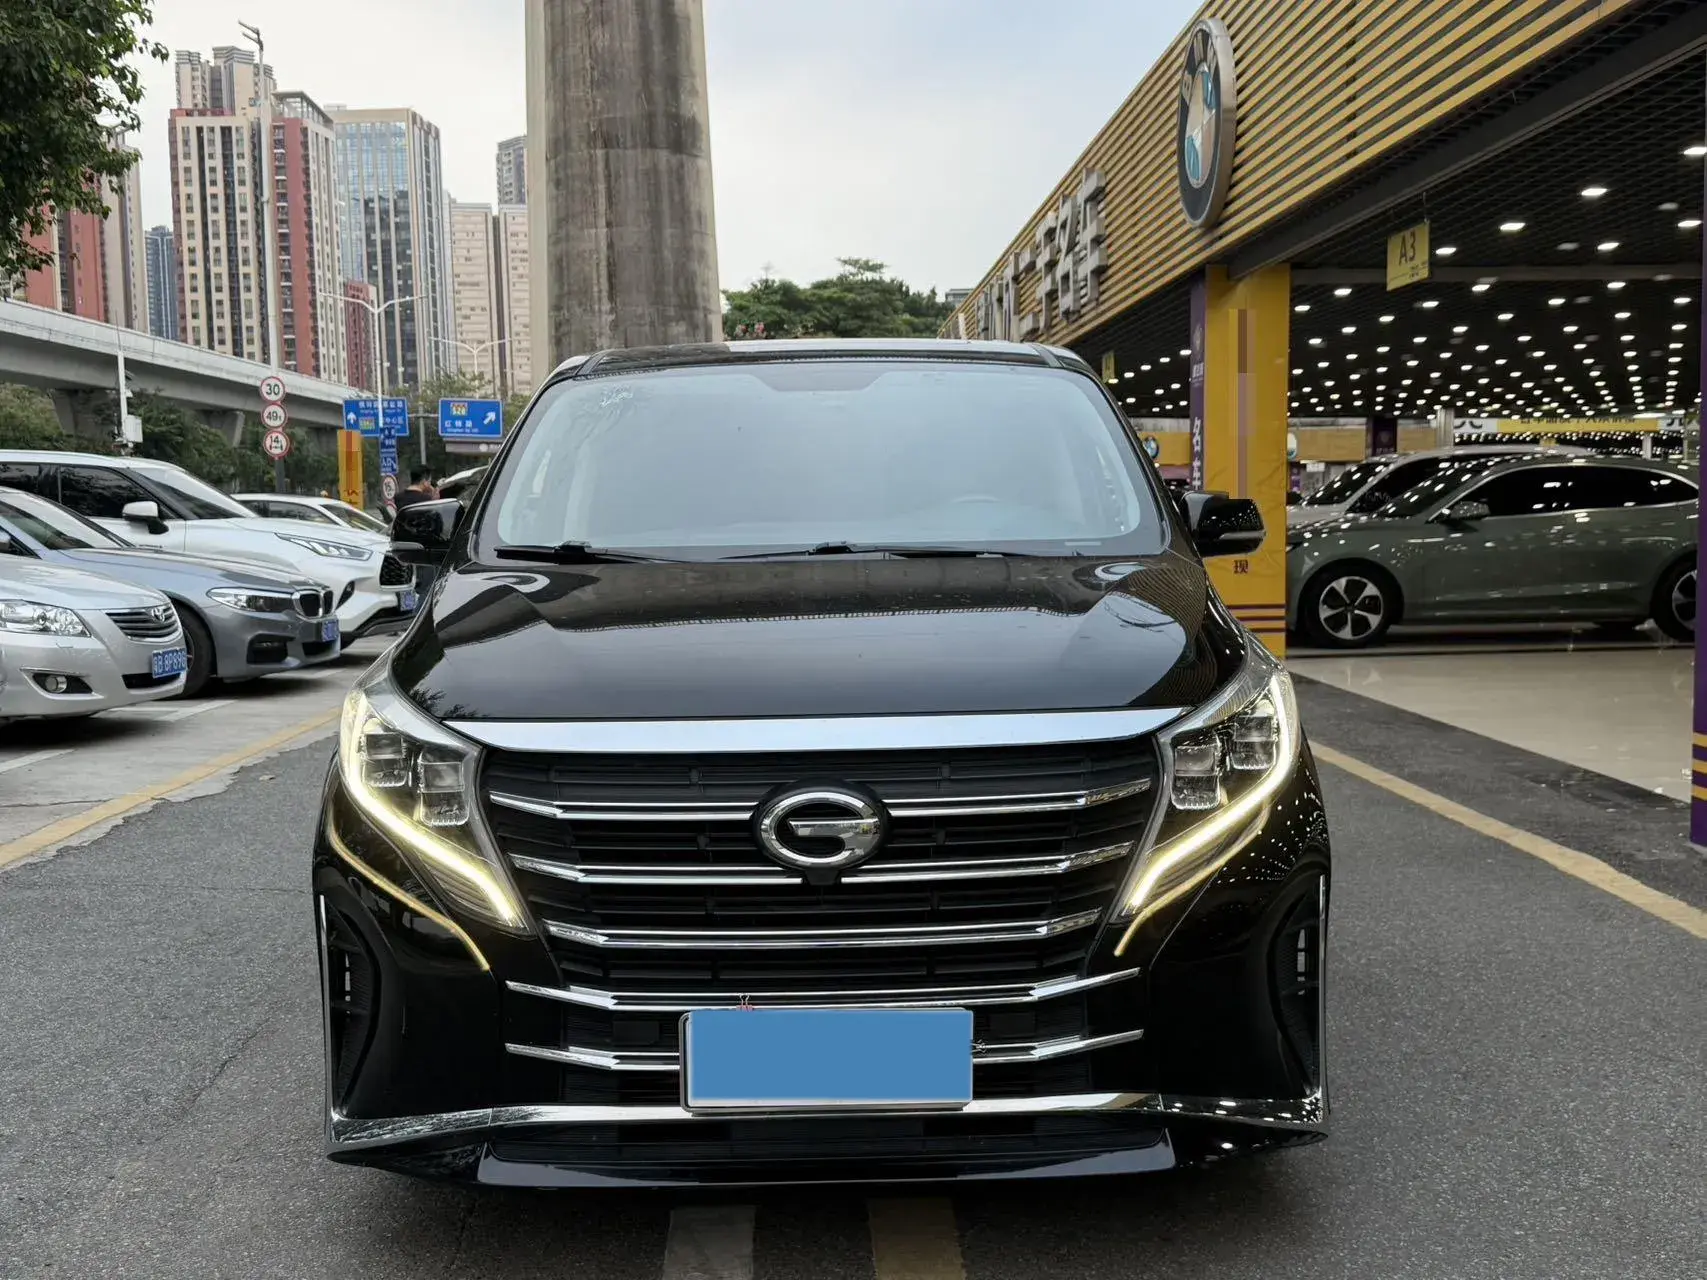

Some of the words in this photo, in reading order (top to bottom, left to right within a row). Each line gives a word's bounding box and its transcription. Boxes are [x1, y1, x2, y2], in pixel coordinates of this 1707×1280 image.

[1181, 29, 1218, 105] BMW
[1399, 229, 1416, 266] A3
[265, 383, 281, 396] 30
